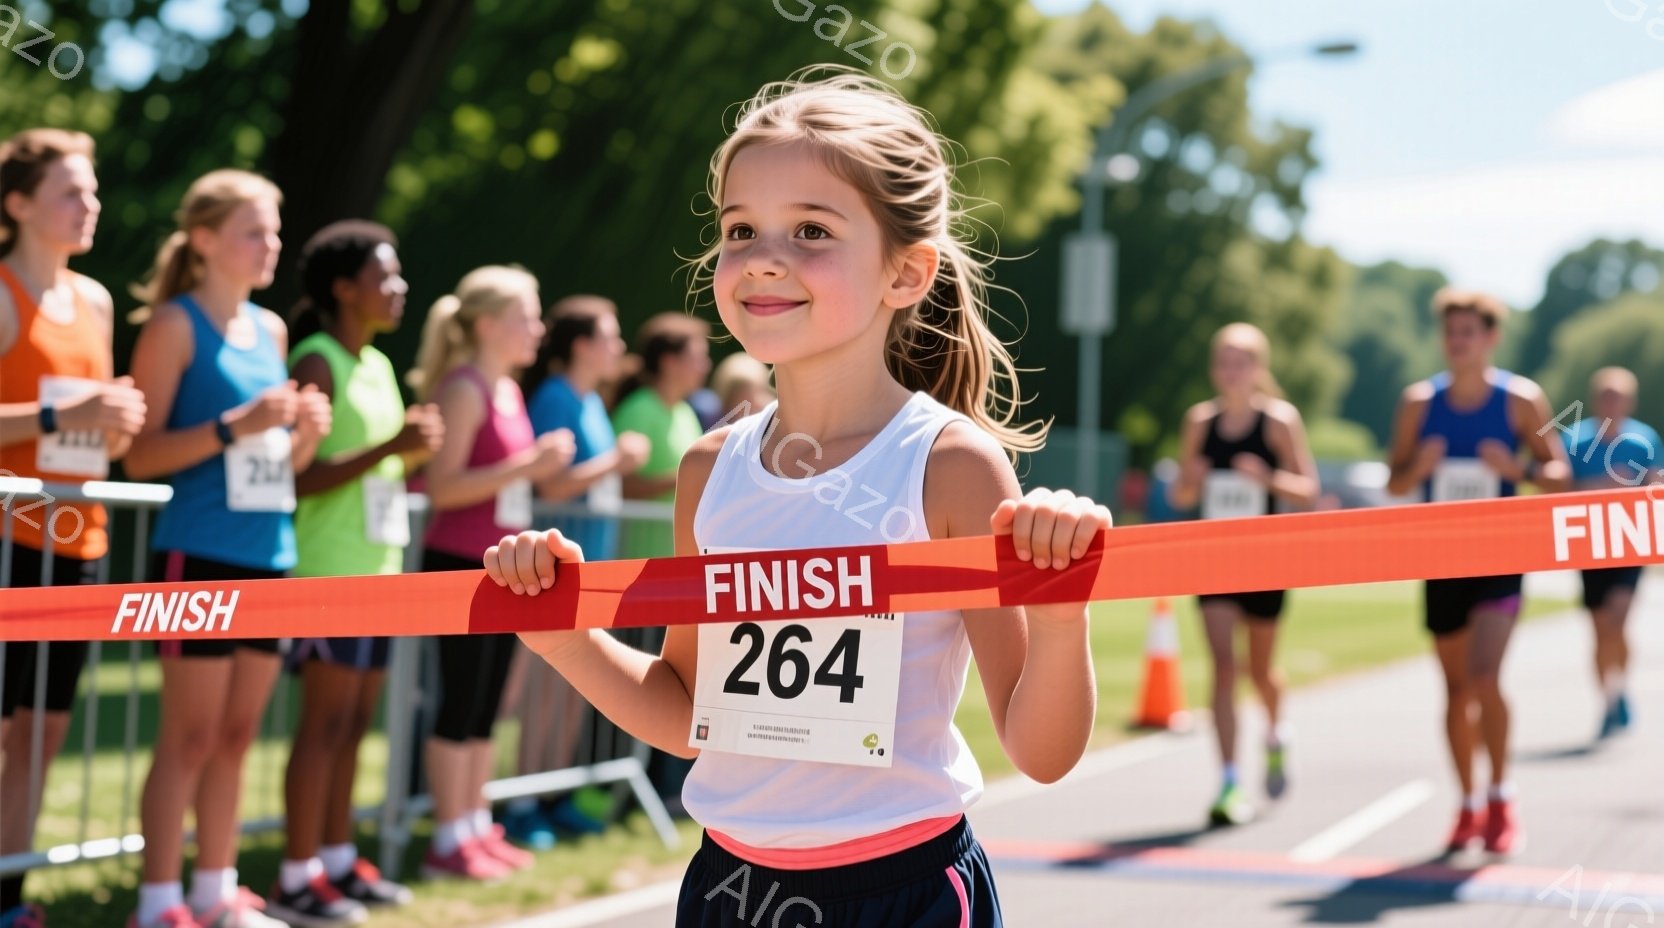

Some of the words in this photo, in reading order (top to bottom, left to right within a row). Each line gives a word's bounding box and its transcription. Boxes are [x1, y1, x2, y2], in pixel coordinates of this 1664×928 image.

[111, 590, 240, 634] FINISH
[704, 555, 873, 614] FINISH
[723, 622, 864, 703] 264
